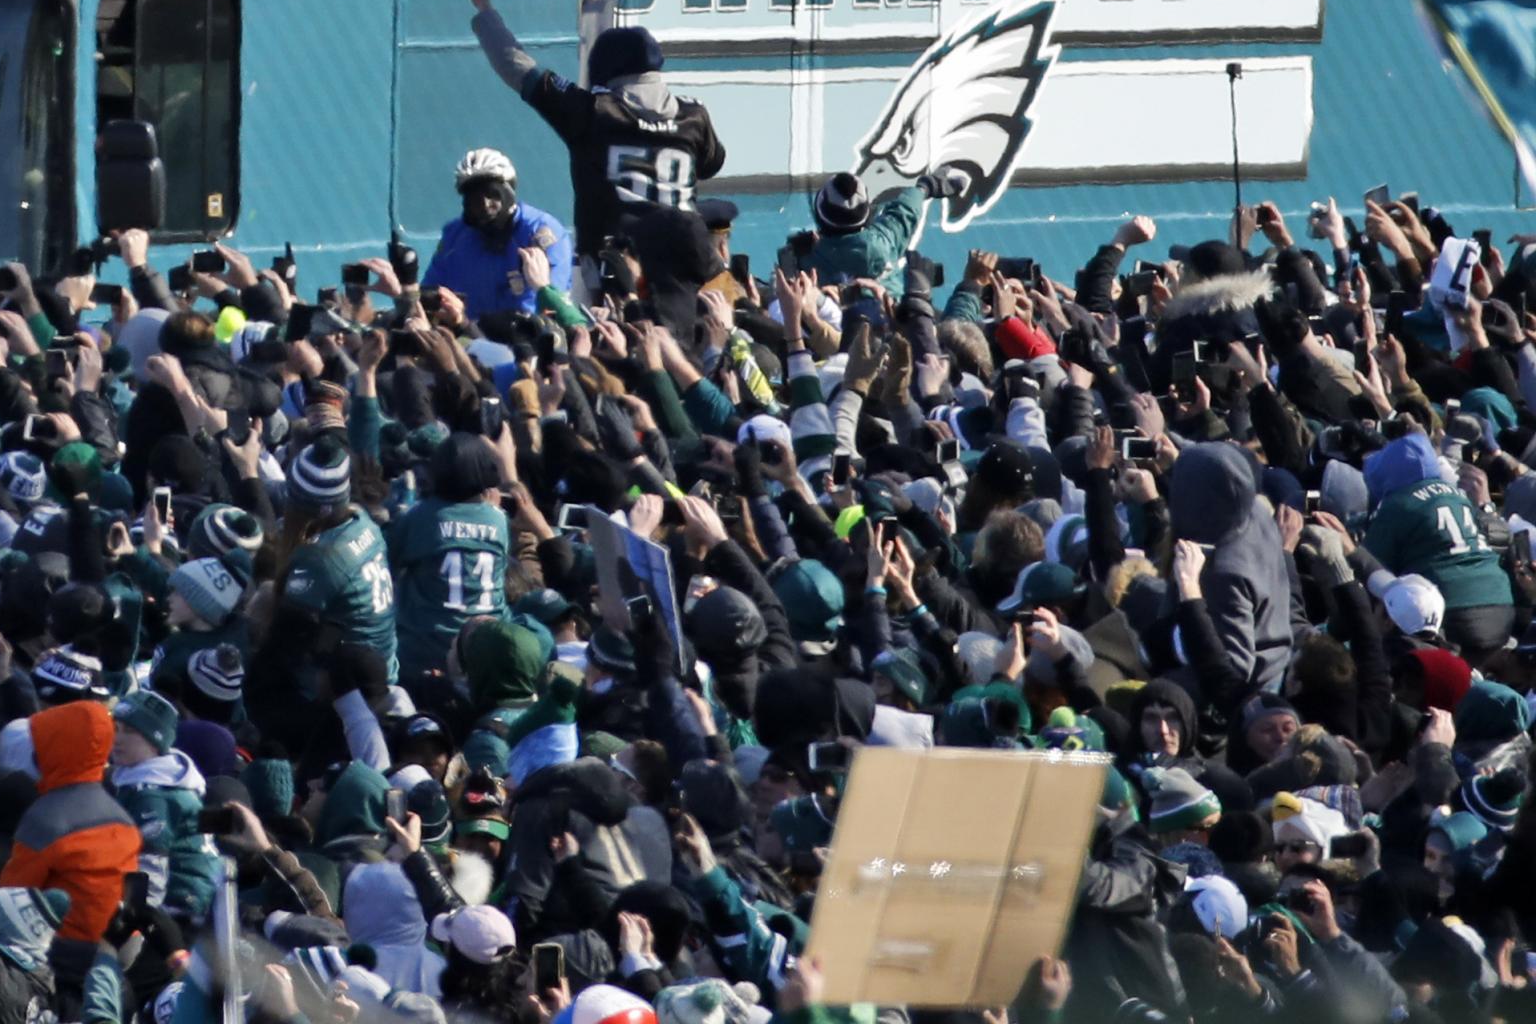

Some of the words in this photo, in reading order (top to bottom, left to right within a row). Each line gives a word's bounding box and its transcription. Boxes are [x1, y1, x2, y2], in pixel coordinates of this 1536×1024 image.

[607, 144, 693, 212] 58
[439, 521, 498, 544] WENTZ
[439, 550, 496, 610] 11
